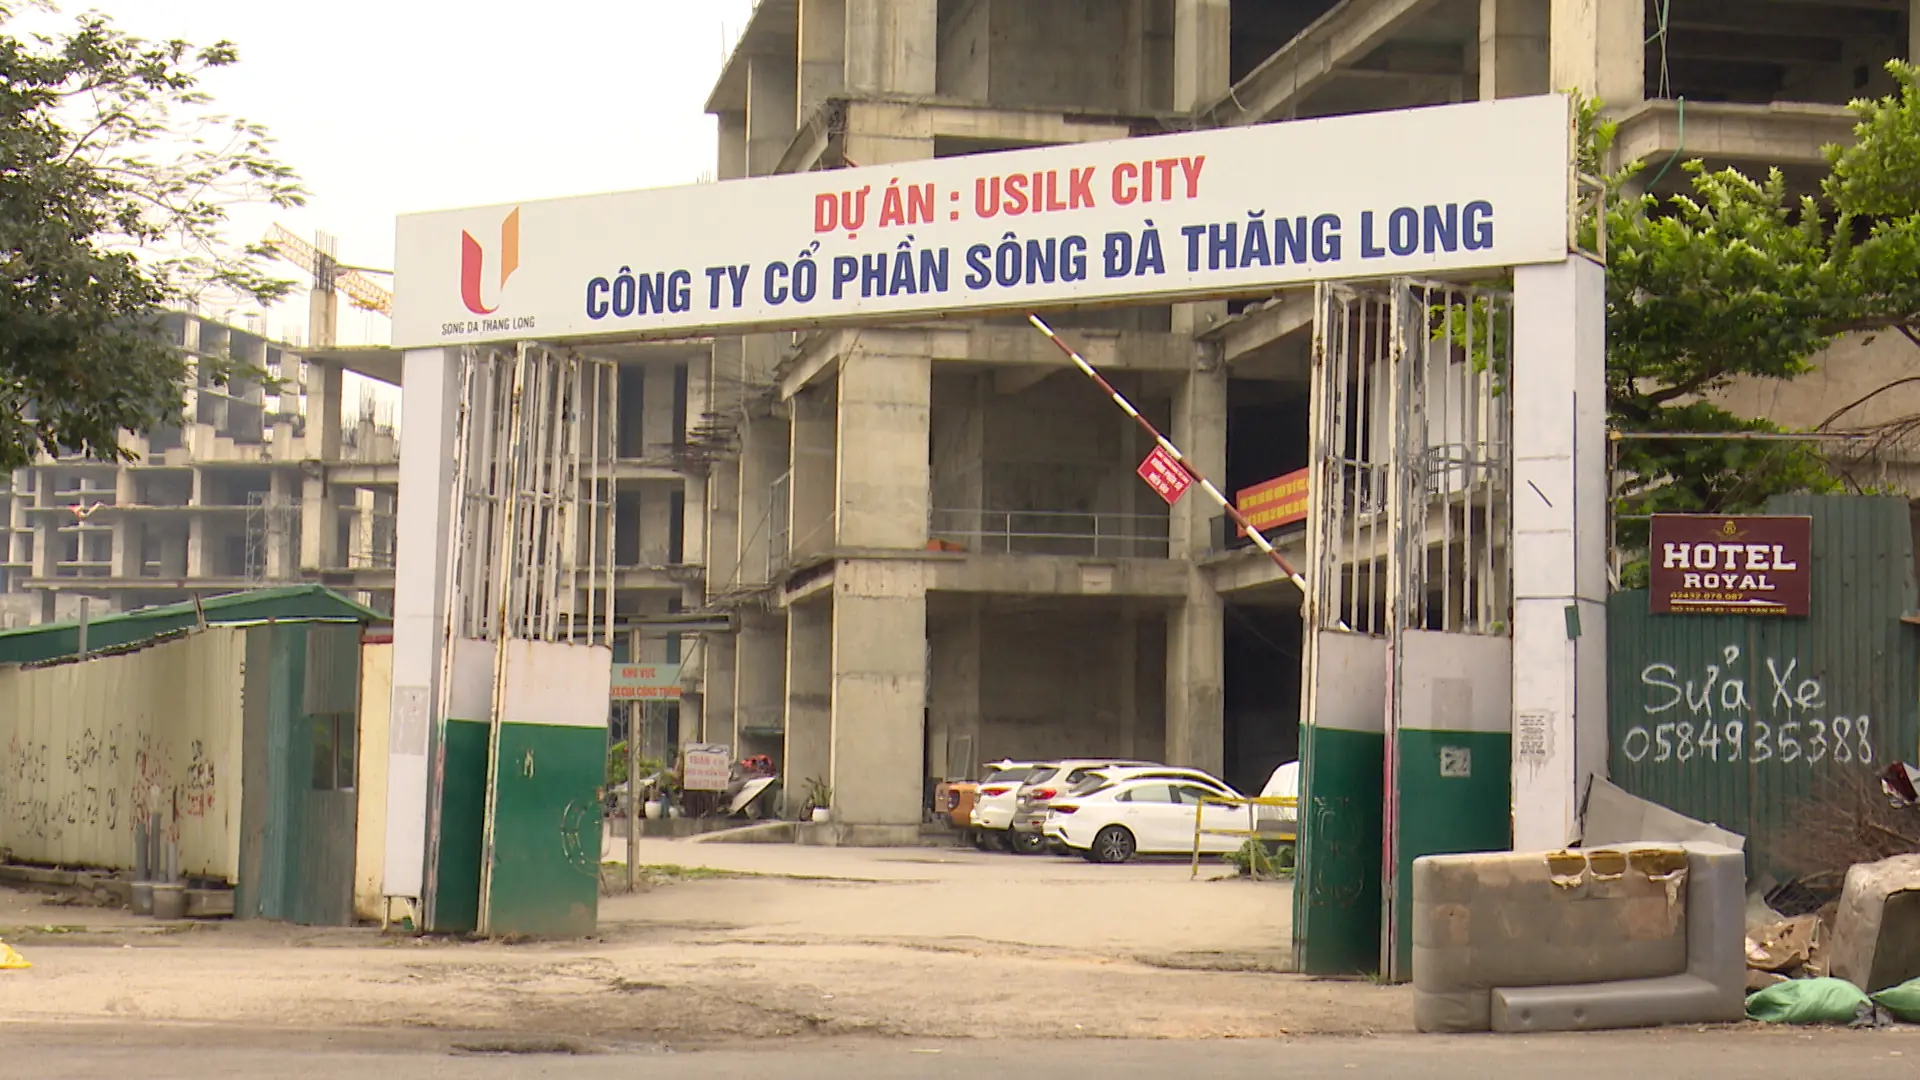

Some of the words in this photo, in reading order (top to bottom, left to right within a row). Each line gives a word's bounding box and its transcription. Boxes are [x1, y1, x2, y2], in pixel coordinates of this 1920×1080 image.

[814, 185, 871, 239] DỰ
[878, 177, 935, 228] ÁN
[974, 166, 1096, 218] USILK
[1111, 155, 1206, 206] CITY
[585, 265, 692, 320] CÔNG
[704, 263, 751, 310] TY
[763, 240, 821, 305] CỔ
[831, 234, 950, 300] PHẦN
[964, 231, 1088, 291] SÔNG
[1102, 219, 1166, 279] ĐÀ
[1181, 209, 1342, 272] THĂNG
[1360, 200, 1494, 259] LONG
[441, 321, 465, 336] SONG
[482, 318, 510, 332] THANG
[512, 316, 535, 330] LONG
[1662, 542, 1797, 571] HOTEL
[1683, 573, 1776, 591] ROYAL
